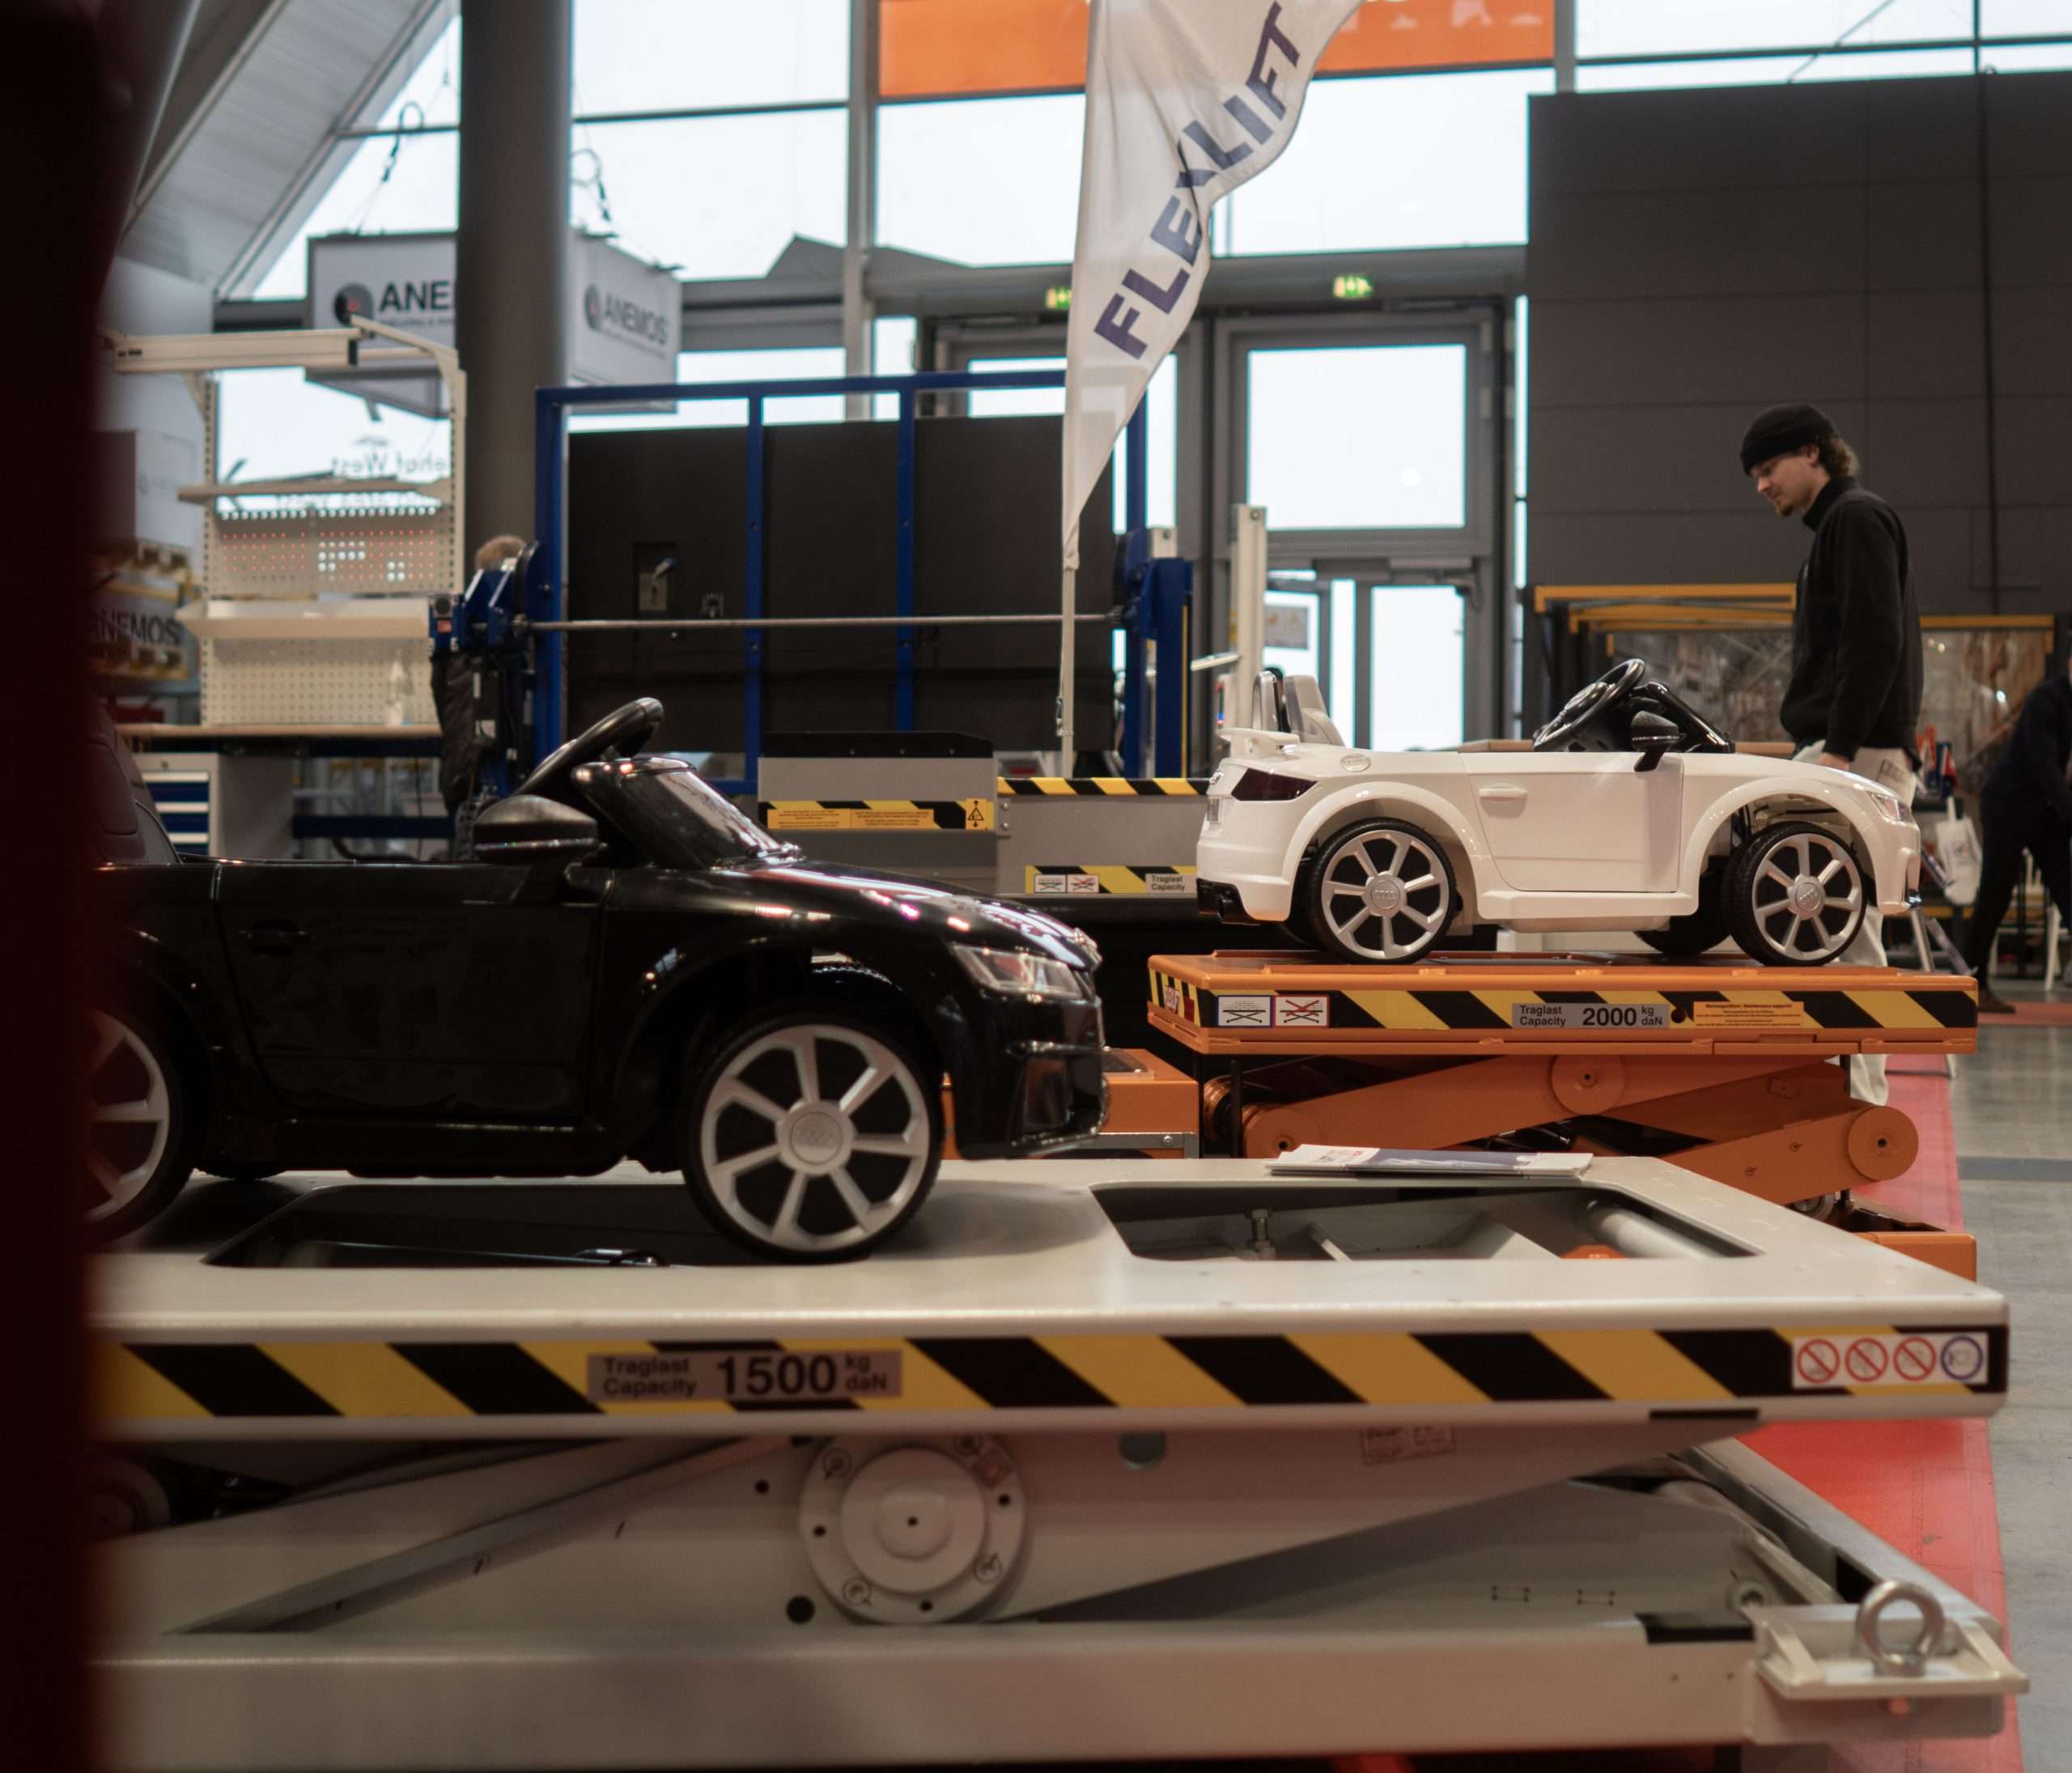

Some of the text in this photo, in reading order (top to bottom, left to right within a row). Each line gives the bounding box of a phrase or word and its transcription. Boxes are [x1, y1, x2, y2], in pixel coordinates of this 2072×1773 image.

[1093, 2, 1301, 359] FLEXLIFT
[379, 281, 451, 313] ANE
[601, 291, 667, 346] ANEMOS
[1152, 883, 1186, 891] Capacity
[1520, 1005, 1562, 1016] Traglast
[1582, 1008, 1637, 1026] 2000
[1641, 1006, 1654, 1015] kg
[1519, 1016, 1566, 1027] Capacity
[1641, 1017, 1663, 1026] daN
[605, 1357, 690, 1378] Traglast
[845, 1354, 871, 1372] kg
[717, 1354, 837, 1396] 1500
[845, 1374, 888, 1392] daN
[604, 1378, 697, 1398] Capacity
